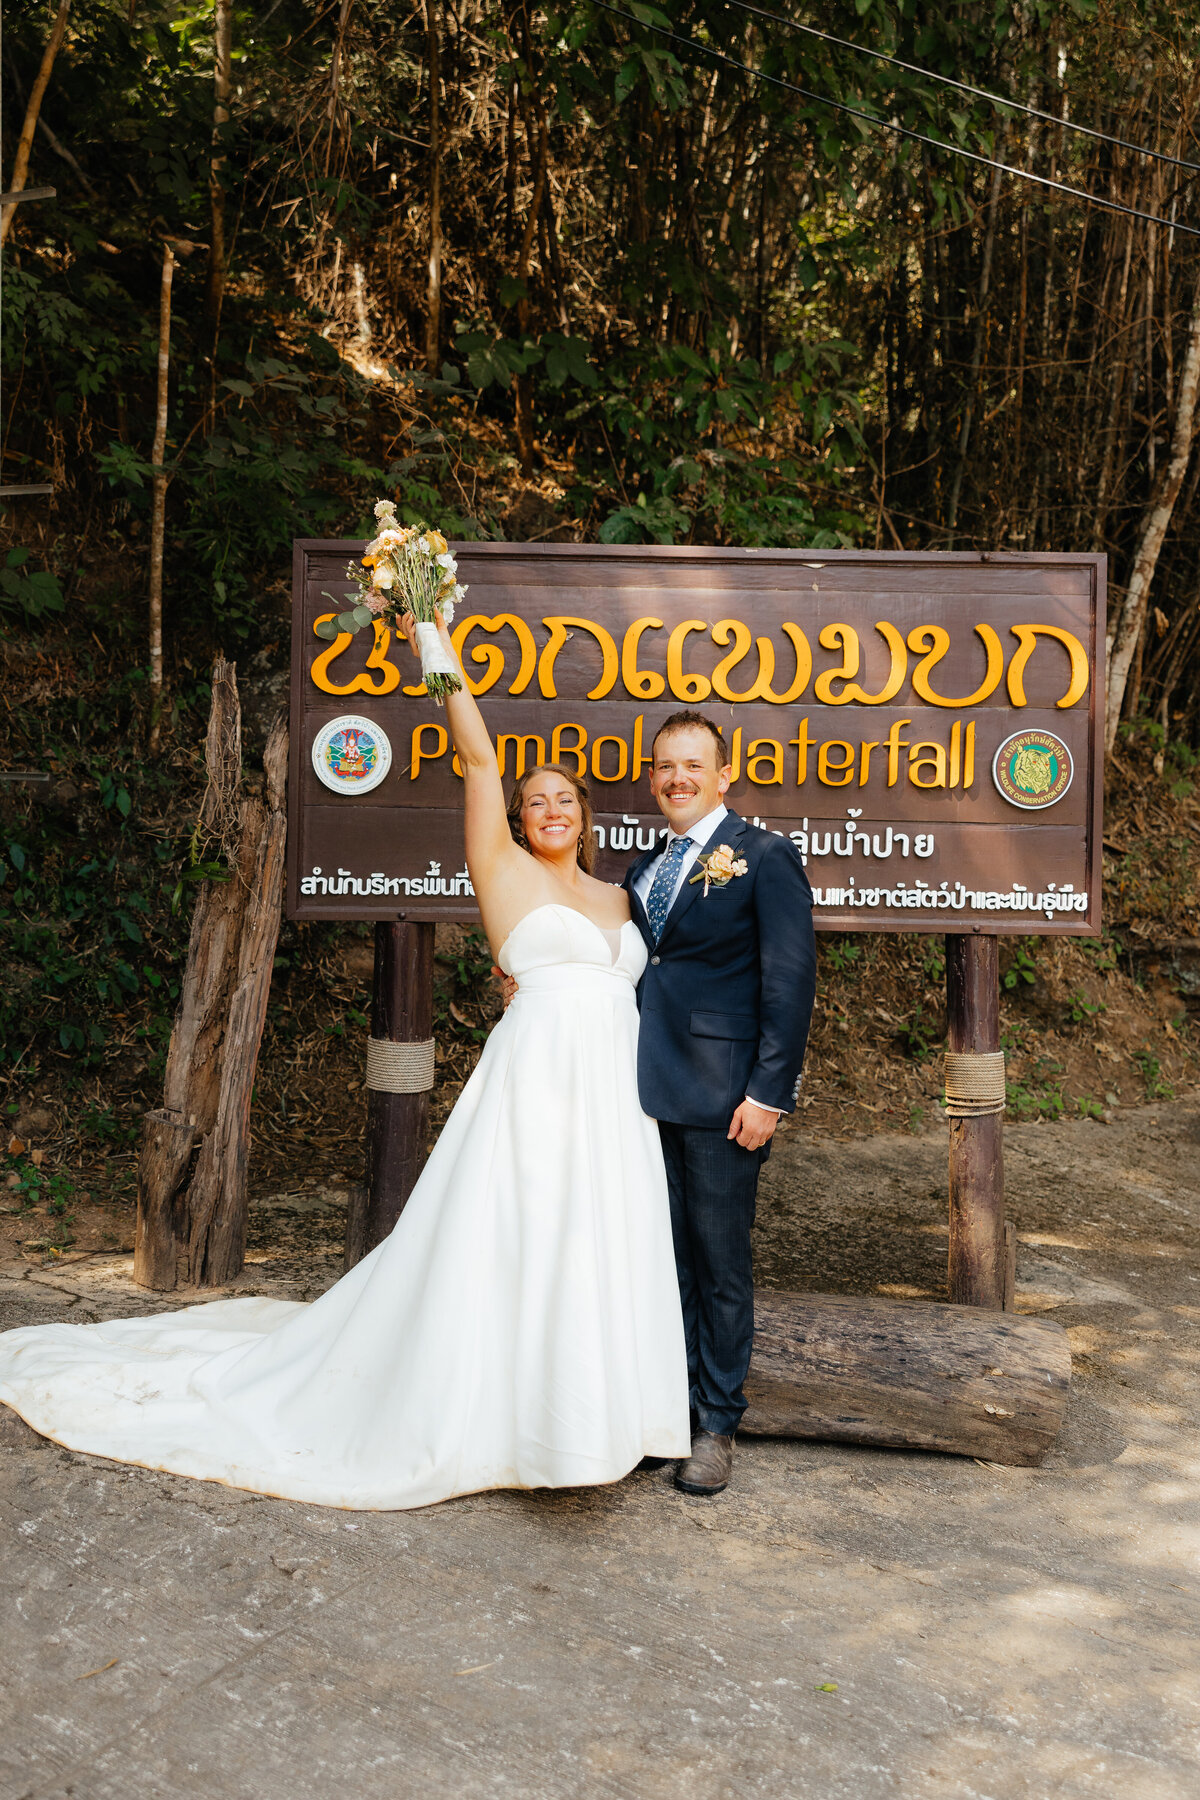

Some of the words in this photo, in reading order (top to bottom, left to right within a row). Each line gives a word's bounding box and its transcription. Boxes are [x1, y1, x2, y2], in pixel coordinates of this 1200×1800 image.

[310, 554, 1089, 709] นตกแพมบก
[1000, 769, 1016, 795] WILDLIFE
[1013, 789, 1057, 804] CONSERVATION
[1055, 771, 1067, 791] OFFICE
[300, 861, 476, 896] สำนักบริหารพื้นที่
